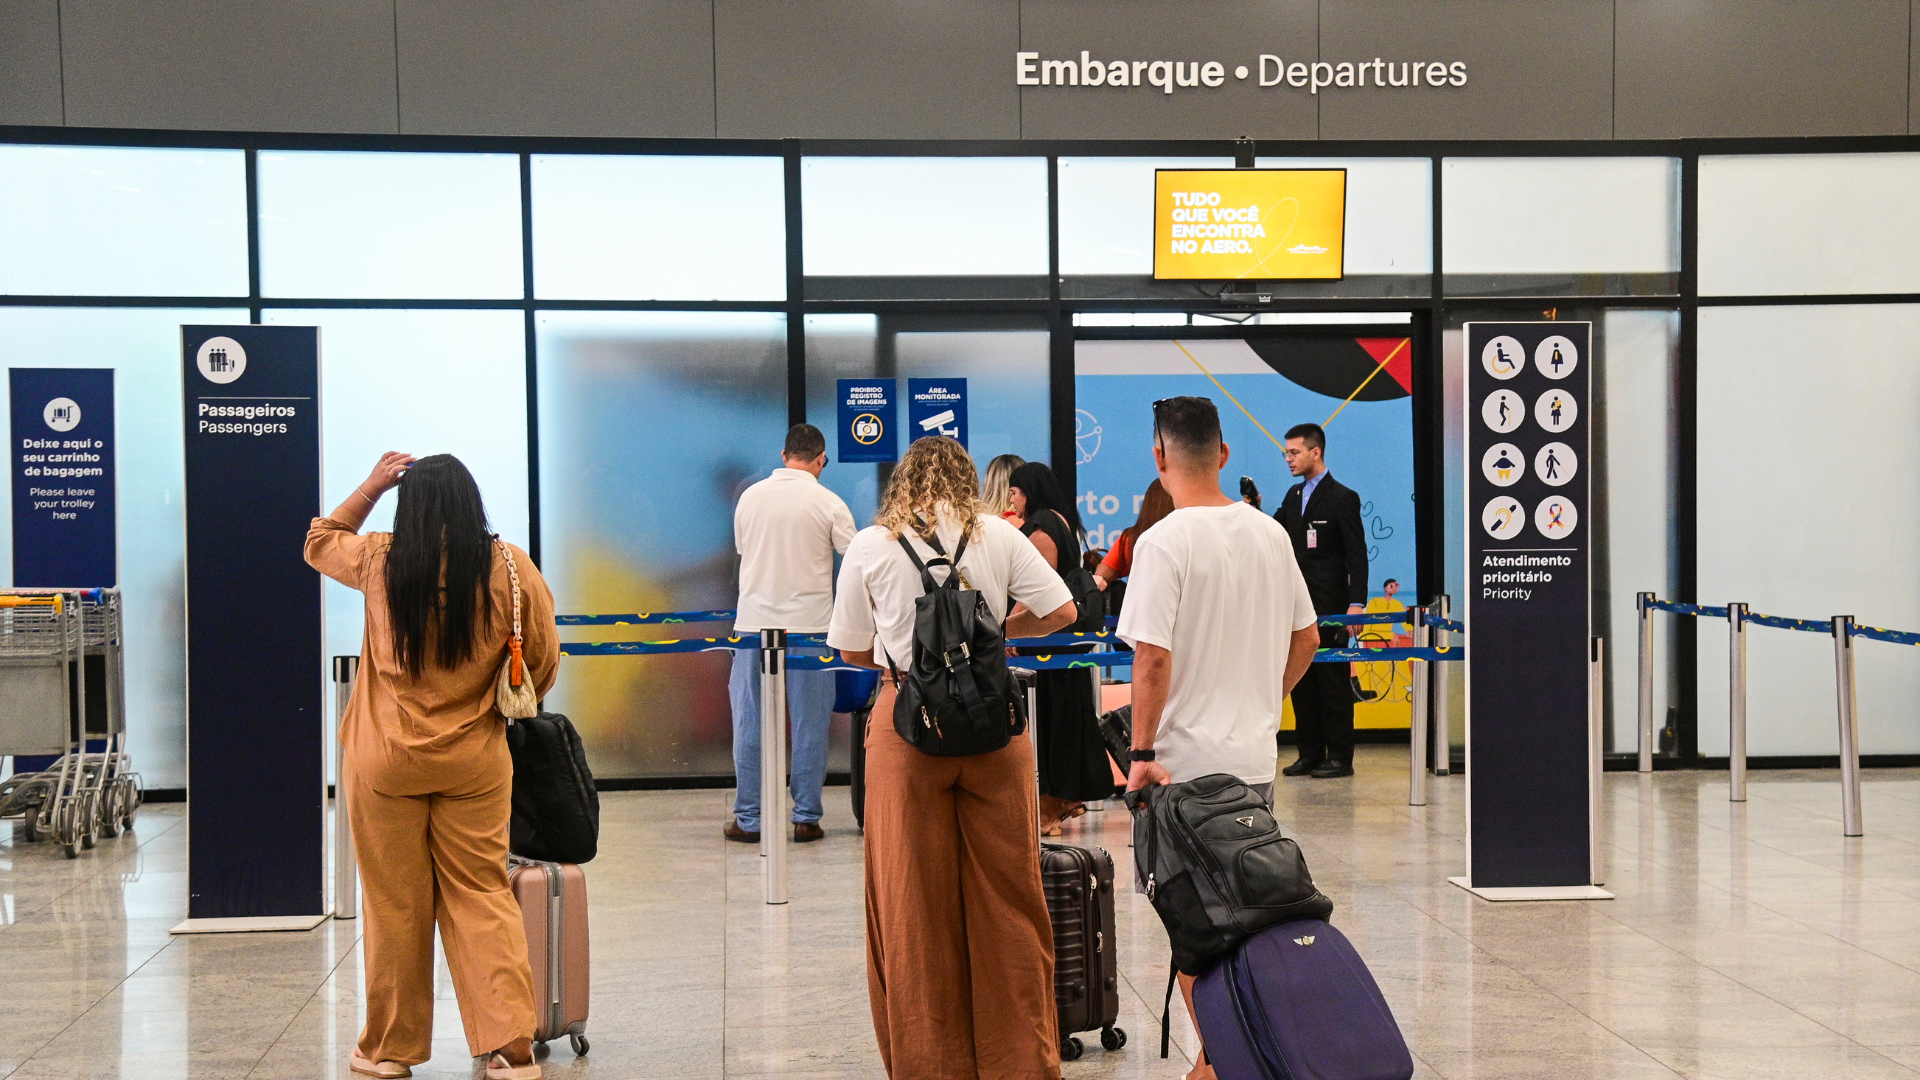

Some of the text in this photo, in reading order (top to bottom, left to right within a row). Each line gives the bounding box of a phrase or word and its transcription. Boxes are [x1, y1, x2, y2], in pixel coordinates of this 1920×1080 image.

[1016, 51, 1468, 95] Embarque Departures
[1172, 192, 1221, 207] TUDO
[1172, 205, 1259, 222] QUE VOCÊ
[1172, 223, 1265, 238] ENCONTRA
[1171, 240, 1253, 254] NO AERO.
[199, 403, 296, 420] Passageiros
[199, 420, 288, 436] Passengers
[23, 438, 103, 450] Deixe aqui o
[23, 452, 100, 463] seu carrinho
[24, 466, 103, 478] de bagagem
[30, 487, 95, 497] Please leave
[34, 498, 95, 510] your trolley
[53, 511, 77, 520] here
[1483, 555, 1572, 567] Atendimento
[1483, 569, 1553, 584] prioritário
[1483, 587, 1532, 601] Priority
